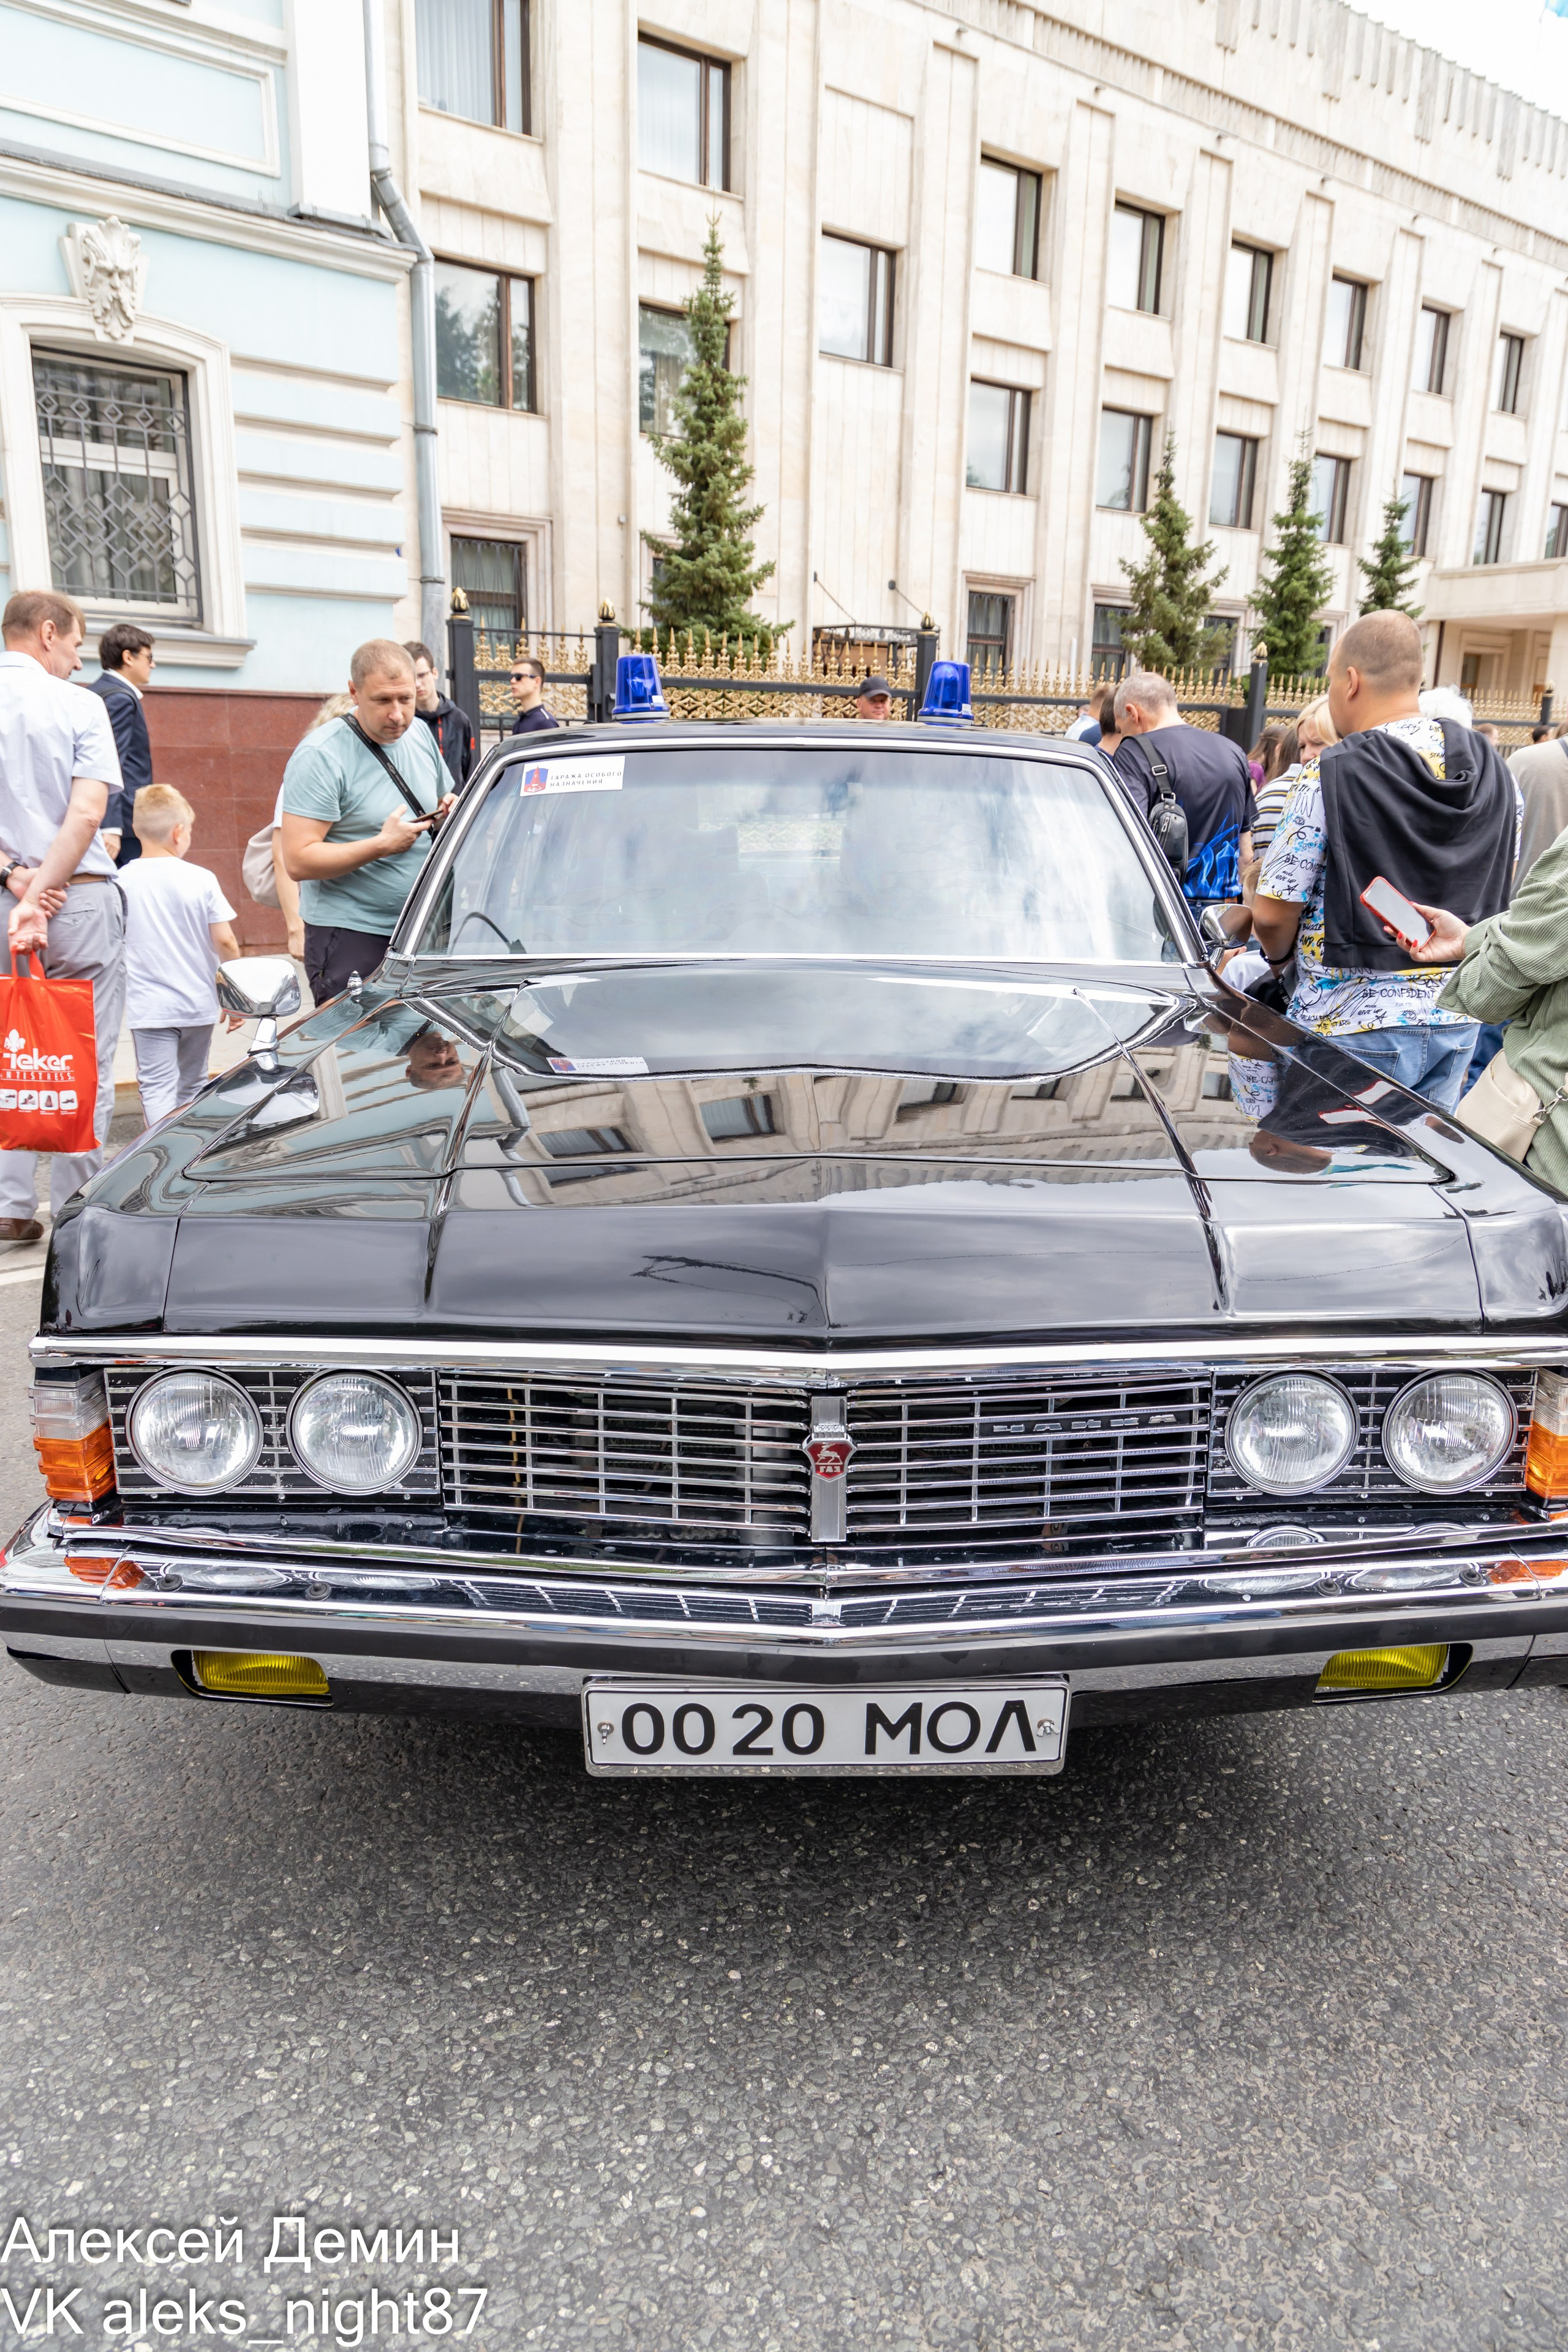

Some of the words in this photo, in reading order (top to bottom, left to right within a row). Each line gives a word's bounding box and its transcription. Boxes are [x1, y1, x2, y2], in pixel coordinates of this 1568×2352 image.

[550, 778, 603, 787] НАЗНАЧЕНИЯ
[993, 1413, 1177, 1433] ЧАЙКА
[864, 1699, 1038, 1755] МОЛ
